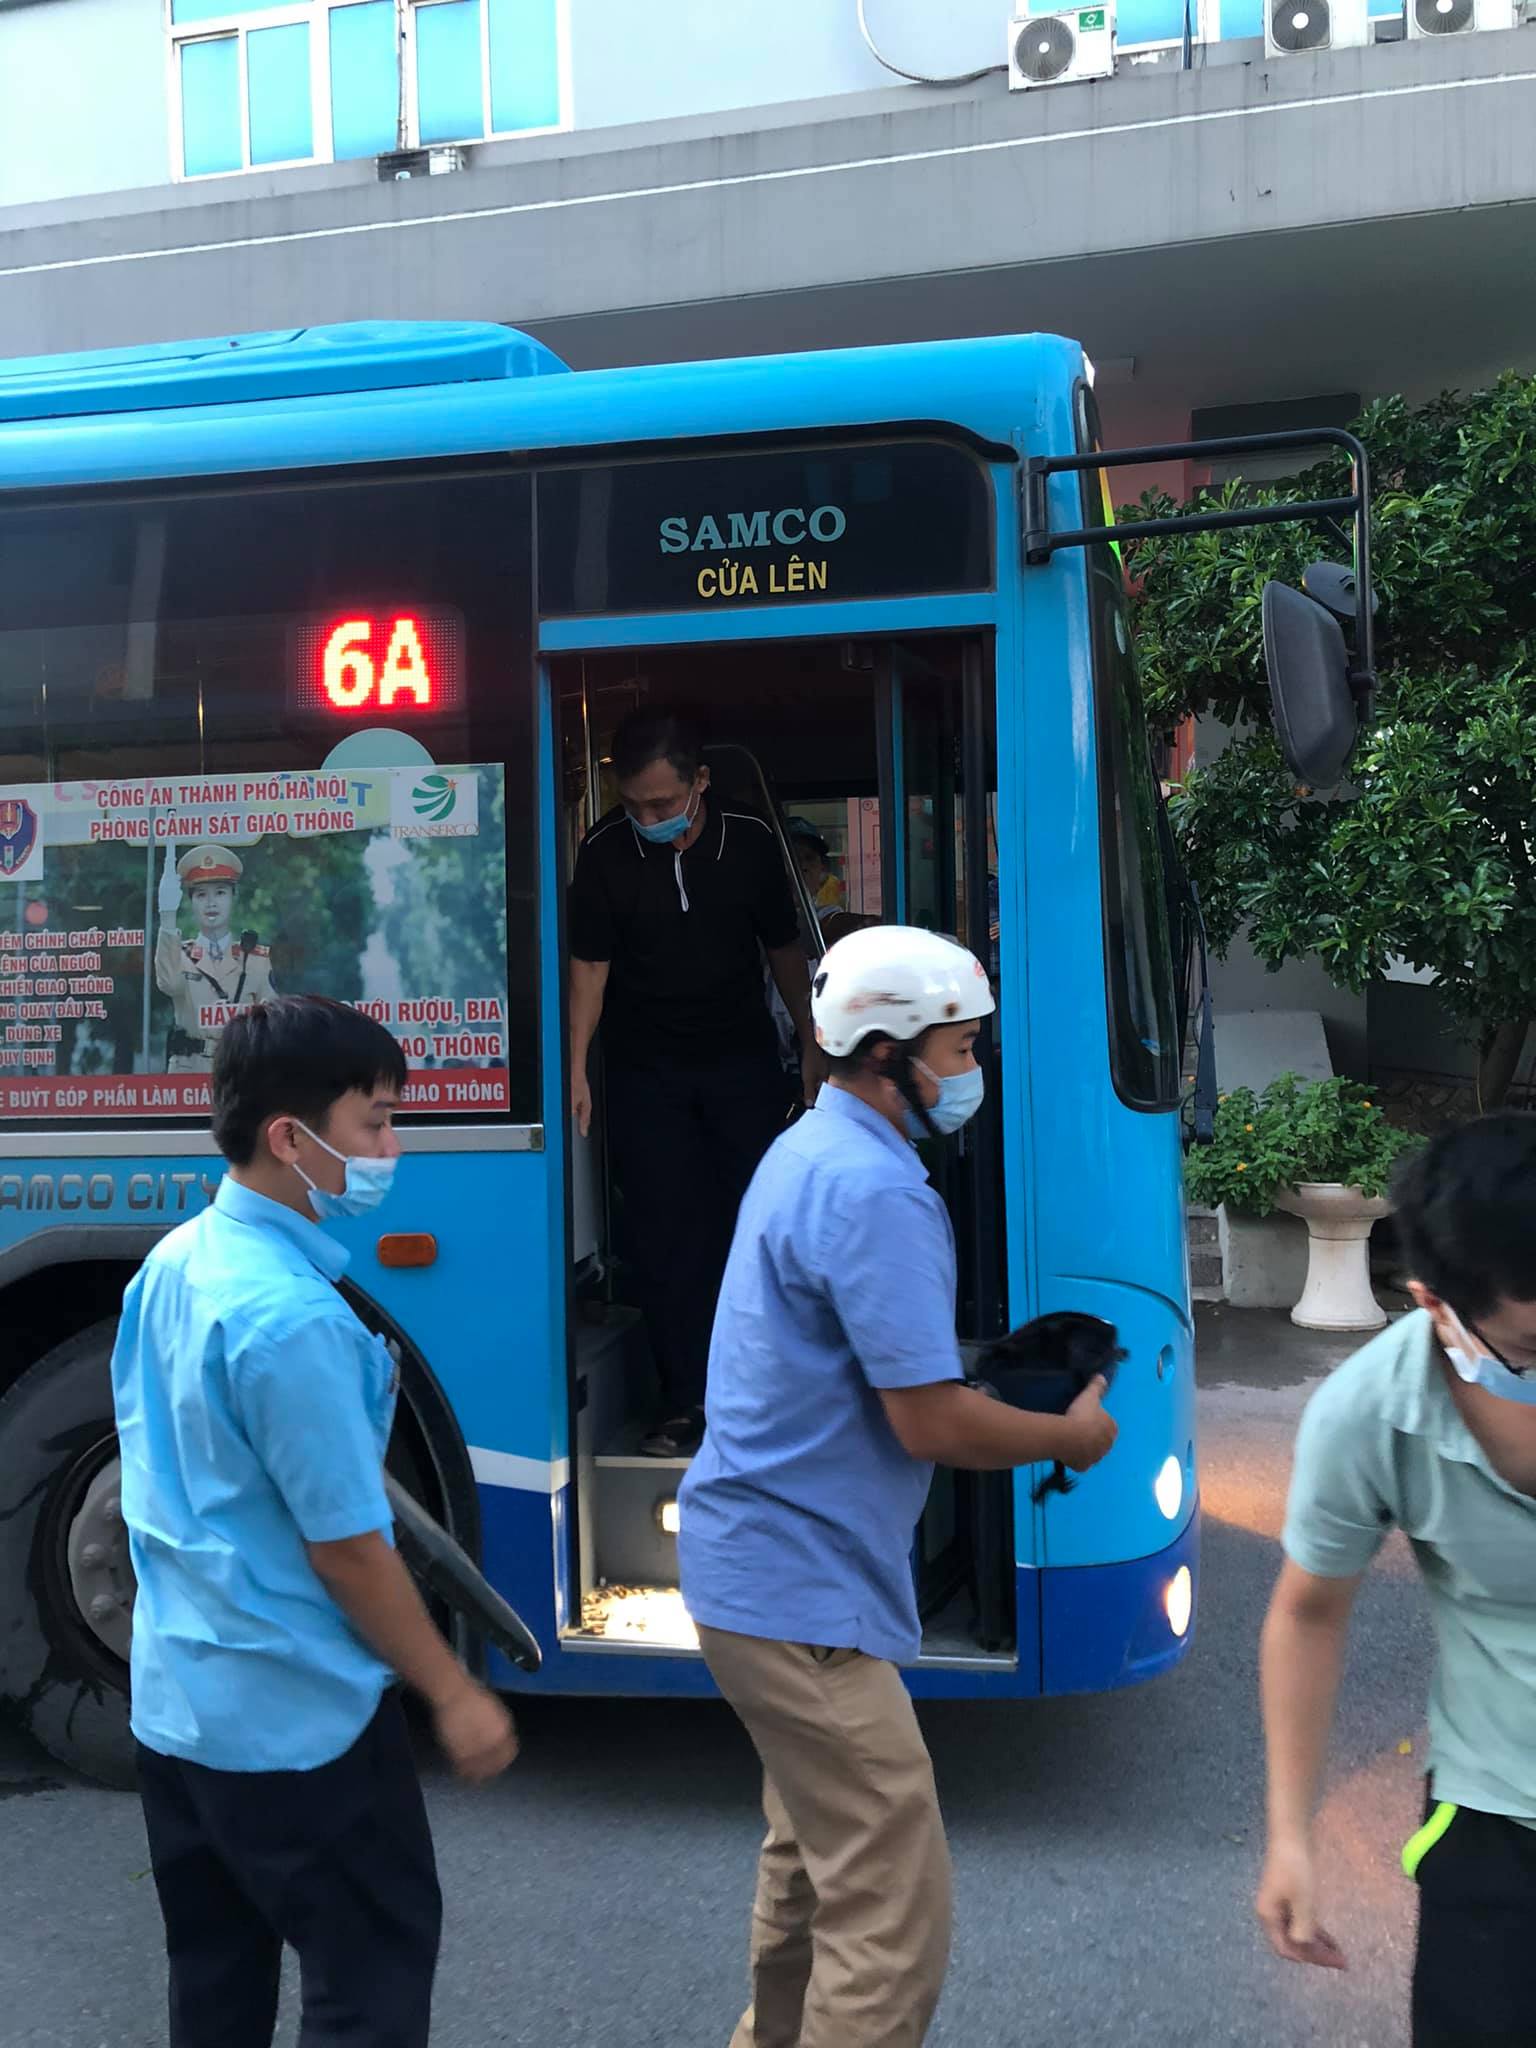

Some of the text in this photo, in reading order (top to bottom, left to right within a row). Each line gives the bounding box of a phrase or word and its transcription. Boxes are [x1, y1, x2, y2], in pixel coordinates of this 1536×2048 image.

[659, 505, 847, 553] SAMCO
[697, 555, 828, 598] CỬA LÊN
[323, 619, 430, 707] 6A
[98, 786, 144, 808] CÔNG
[150, 787, 173, 806] AN
[179, 781, 236, 804] THÀNH
[244, 775, 279, 801] PHỐ
[286, 777, 310, 800] HÀ
[316, 775, 347, 801] NỘI
[91, 808, 355, 840] PHÒNG CẢNH SÁT GIAO THÔNG
[108, 926, 144, 946] HÀNH
[1, 954, 28, 976] ỆNH
[30, 952, 57, 972] CỦA
[36, 978, 67, 996] GIAO
[70, 975, 113, 994] THÔNG
[0, 1004, 16, 1018] NG
[20, 1002, 53, 1020] QUAY
[398, 997, 460, 1027] RƯỢU,
[468, 1000, 500, 1020] BIA
[44, 1026, 62, 1041] XE
[433, 1032, 500, 1056] THÔNG
[23, 1049, 55, 1068] ĐỊNH
[9, 1087, 50, 1108] BUÝT
[55, 1085, 88, 1107] GÓP
[143, 1084, 177, 1106] LÀM
[183, 1082, 216, 1106] GIẢ
[446, 1079, 504, 1101] THÔNG
[0, 1174, 113, 1211] AMCO
